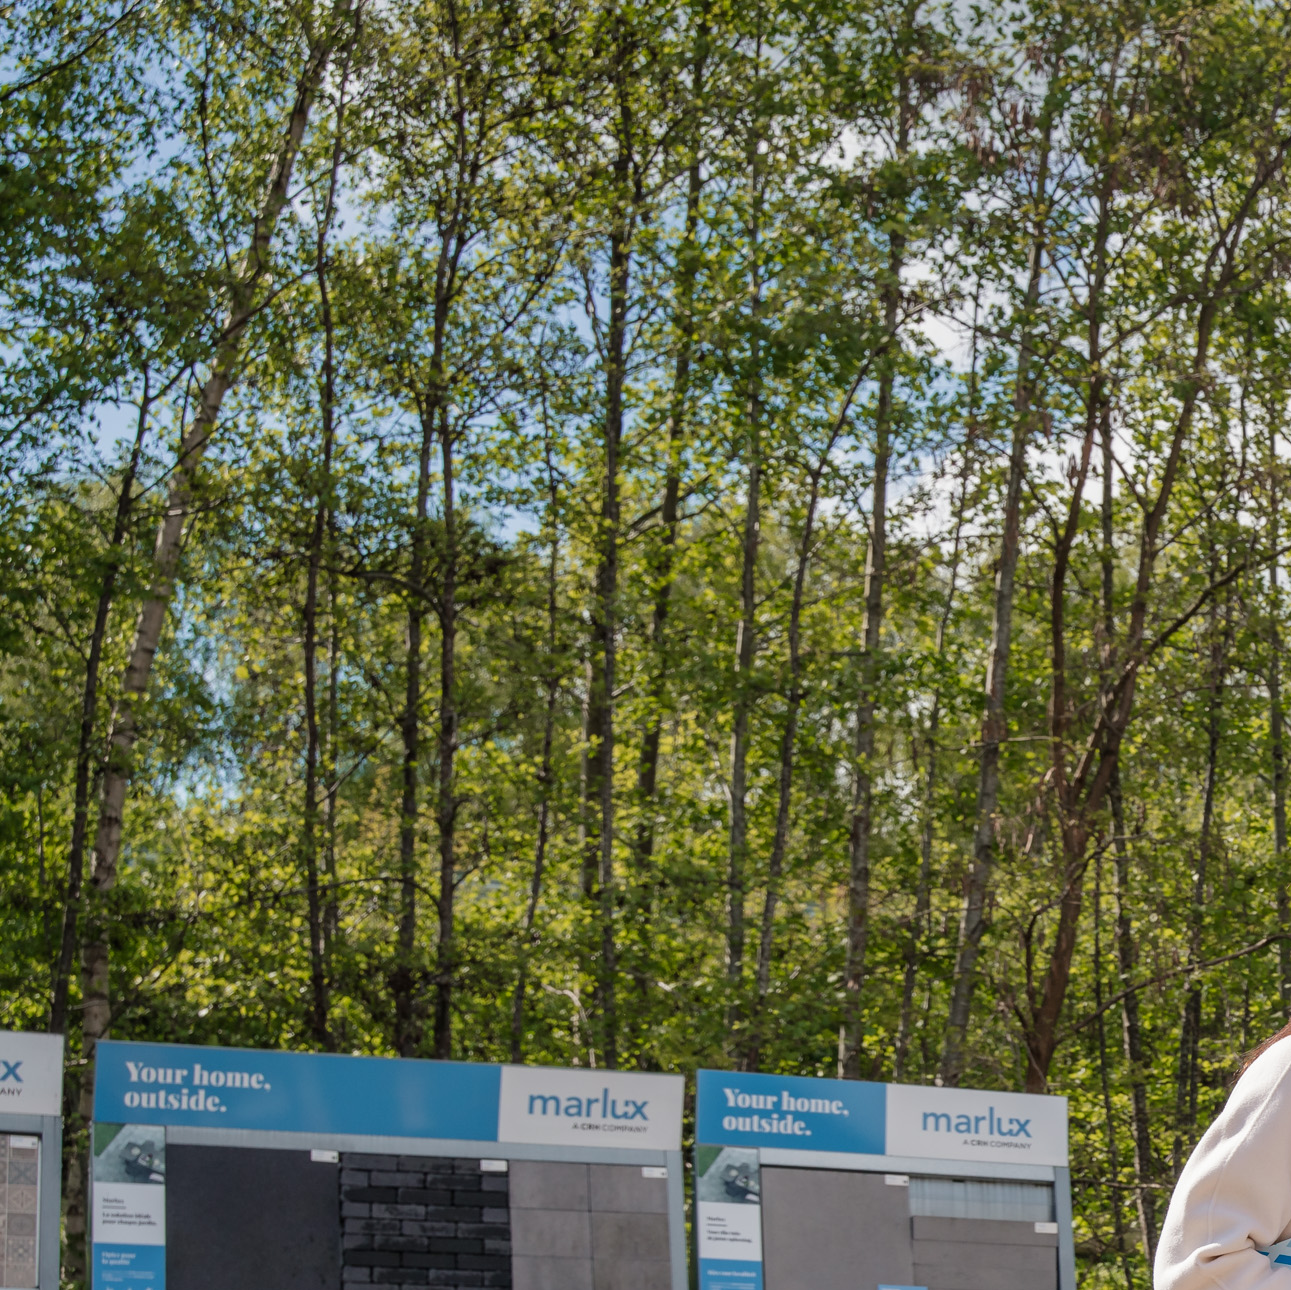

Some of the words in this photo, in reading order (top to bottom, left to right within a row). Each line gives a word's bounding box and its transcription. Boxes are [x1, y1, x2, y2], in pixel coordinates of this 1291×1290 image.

[125, 1061, 189, 1085] Your
[193, 1063, 272, 1091] home,
[123, 1088, 228, 1112] outside.
[527, 1087, 649, 1121] marlux
[722, 1088, 778, 1109] Your
[781, 1090, 850, 1117] home,
[722, 1114, 813, 1136] outside.
[922, 1106, 1033, 1138] marlux
[970, 1139, 989, 1147] CRH
[990, 1140, 1032, 1150] COMPANY
